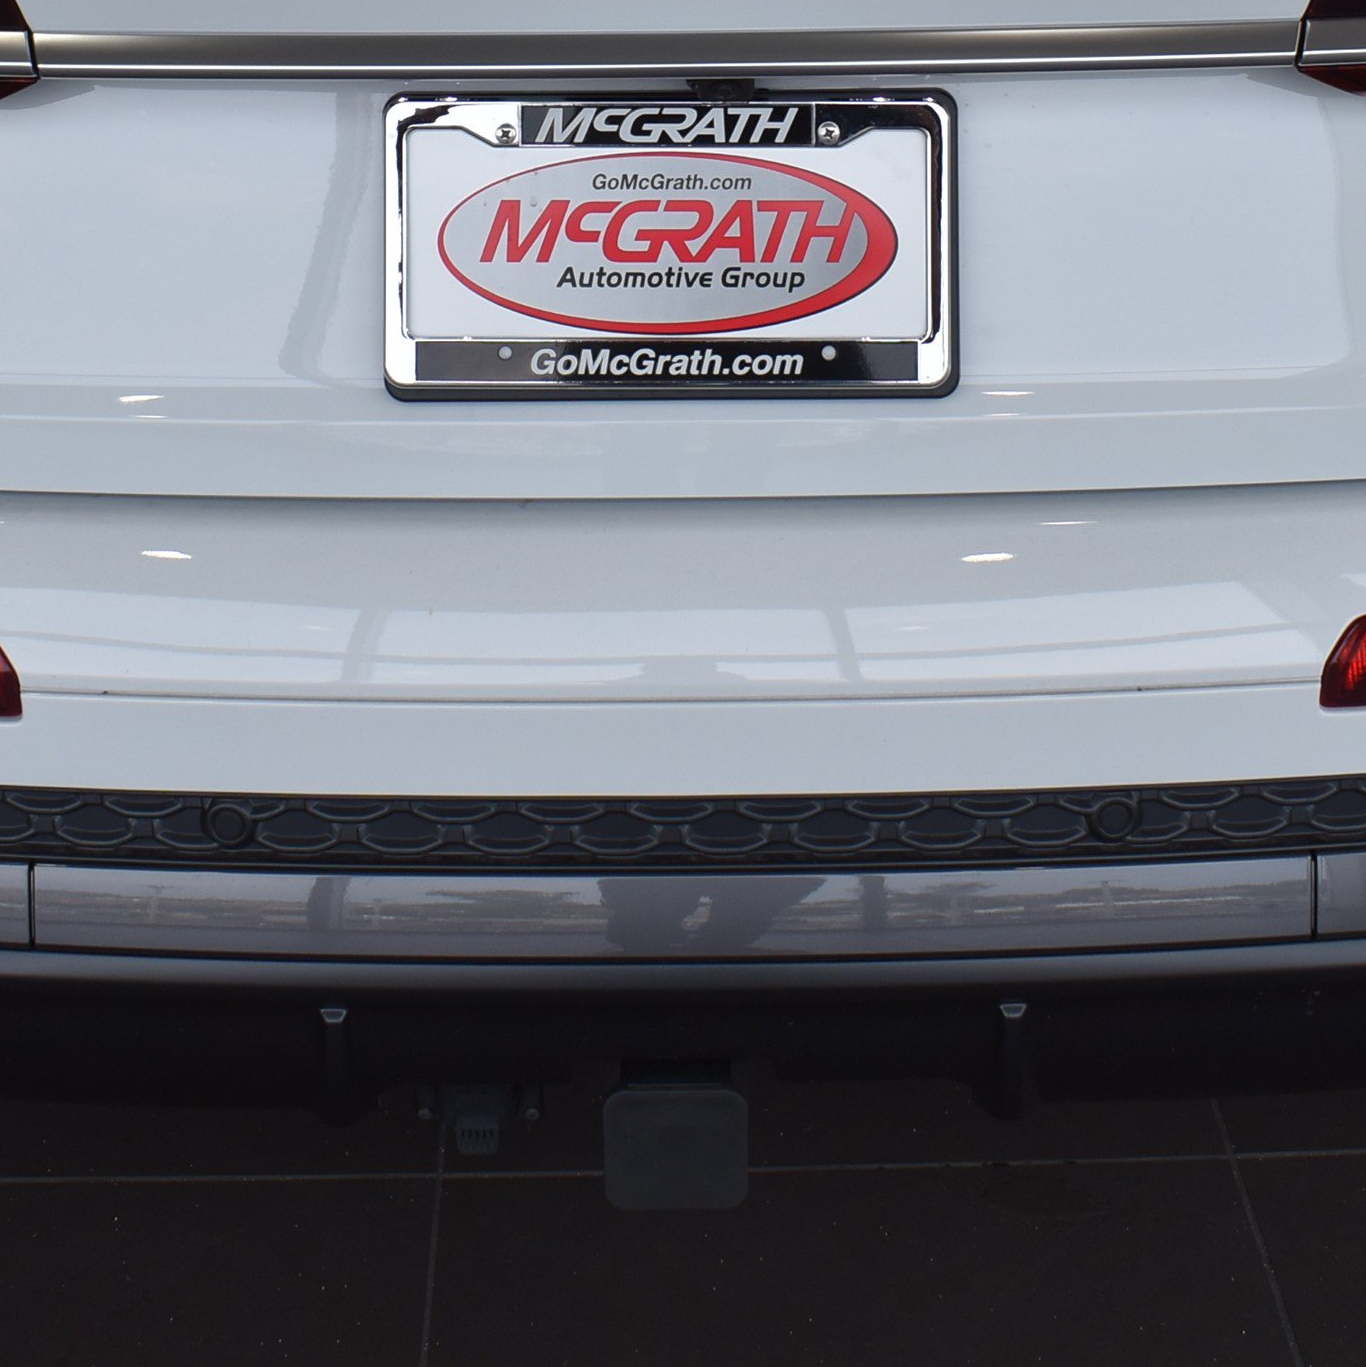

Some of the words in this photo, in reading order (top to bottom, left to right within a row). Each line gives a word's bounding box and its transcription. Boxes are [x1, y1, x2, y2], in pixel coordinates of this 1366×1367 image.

[591, 172, 752, 193] GoMcGrath.com
[556, 266, 714, 289] Automotive
[721, 268, 806, 293] Group
[530, 348, 804, 376] GoMcGrath.com
